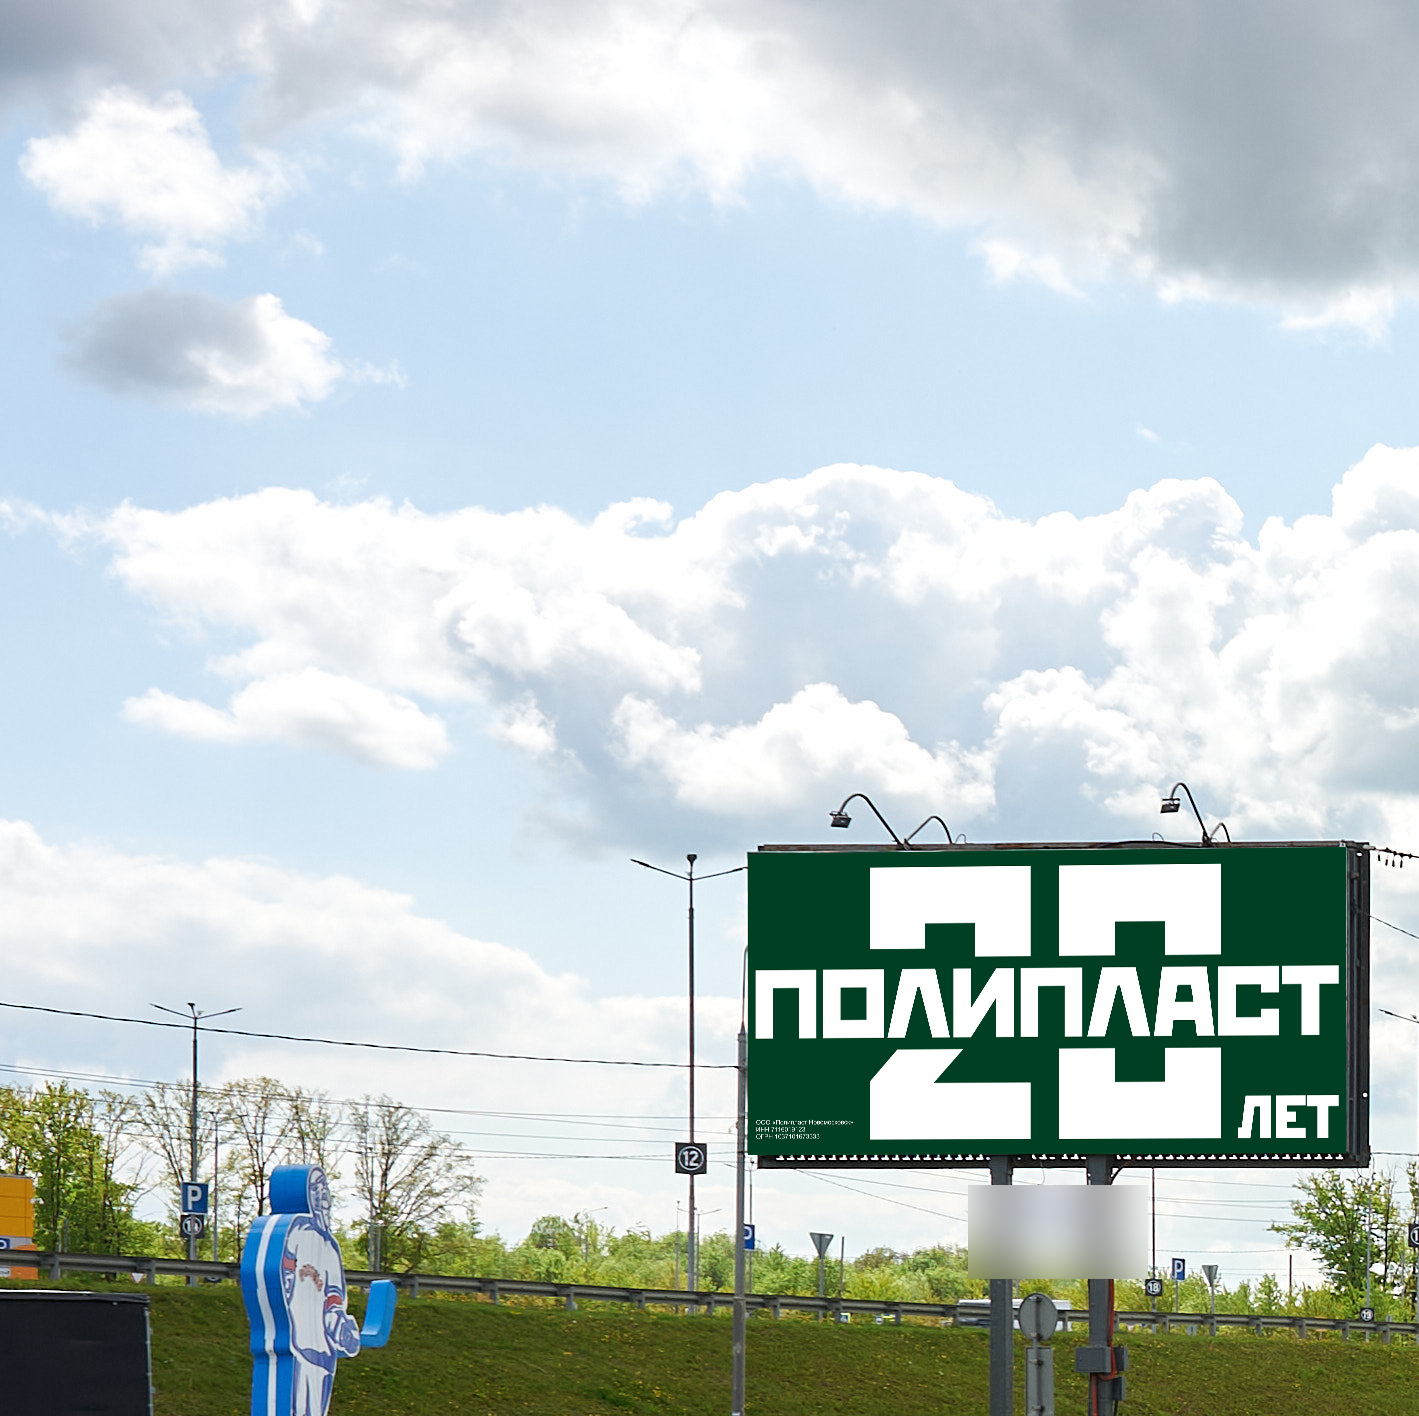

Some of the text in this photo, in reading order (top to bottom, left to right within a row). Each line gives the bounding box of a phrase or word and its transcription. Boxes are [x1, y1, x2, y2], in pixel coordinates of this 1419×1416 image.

[756, 966, 1339, 1038] ПОЛИПЛАСТ
[1238, 1095, 1339, 1138] ЛЕТ
[683, 1150, 698, 1167] 12
[187, 1185, 202, 1210] P
[1174, 1260, 1184, 1279] P
[1149, 1282, 1160, 1291] 18
